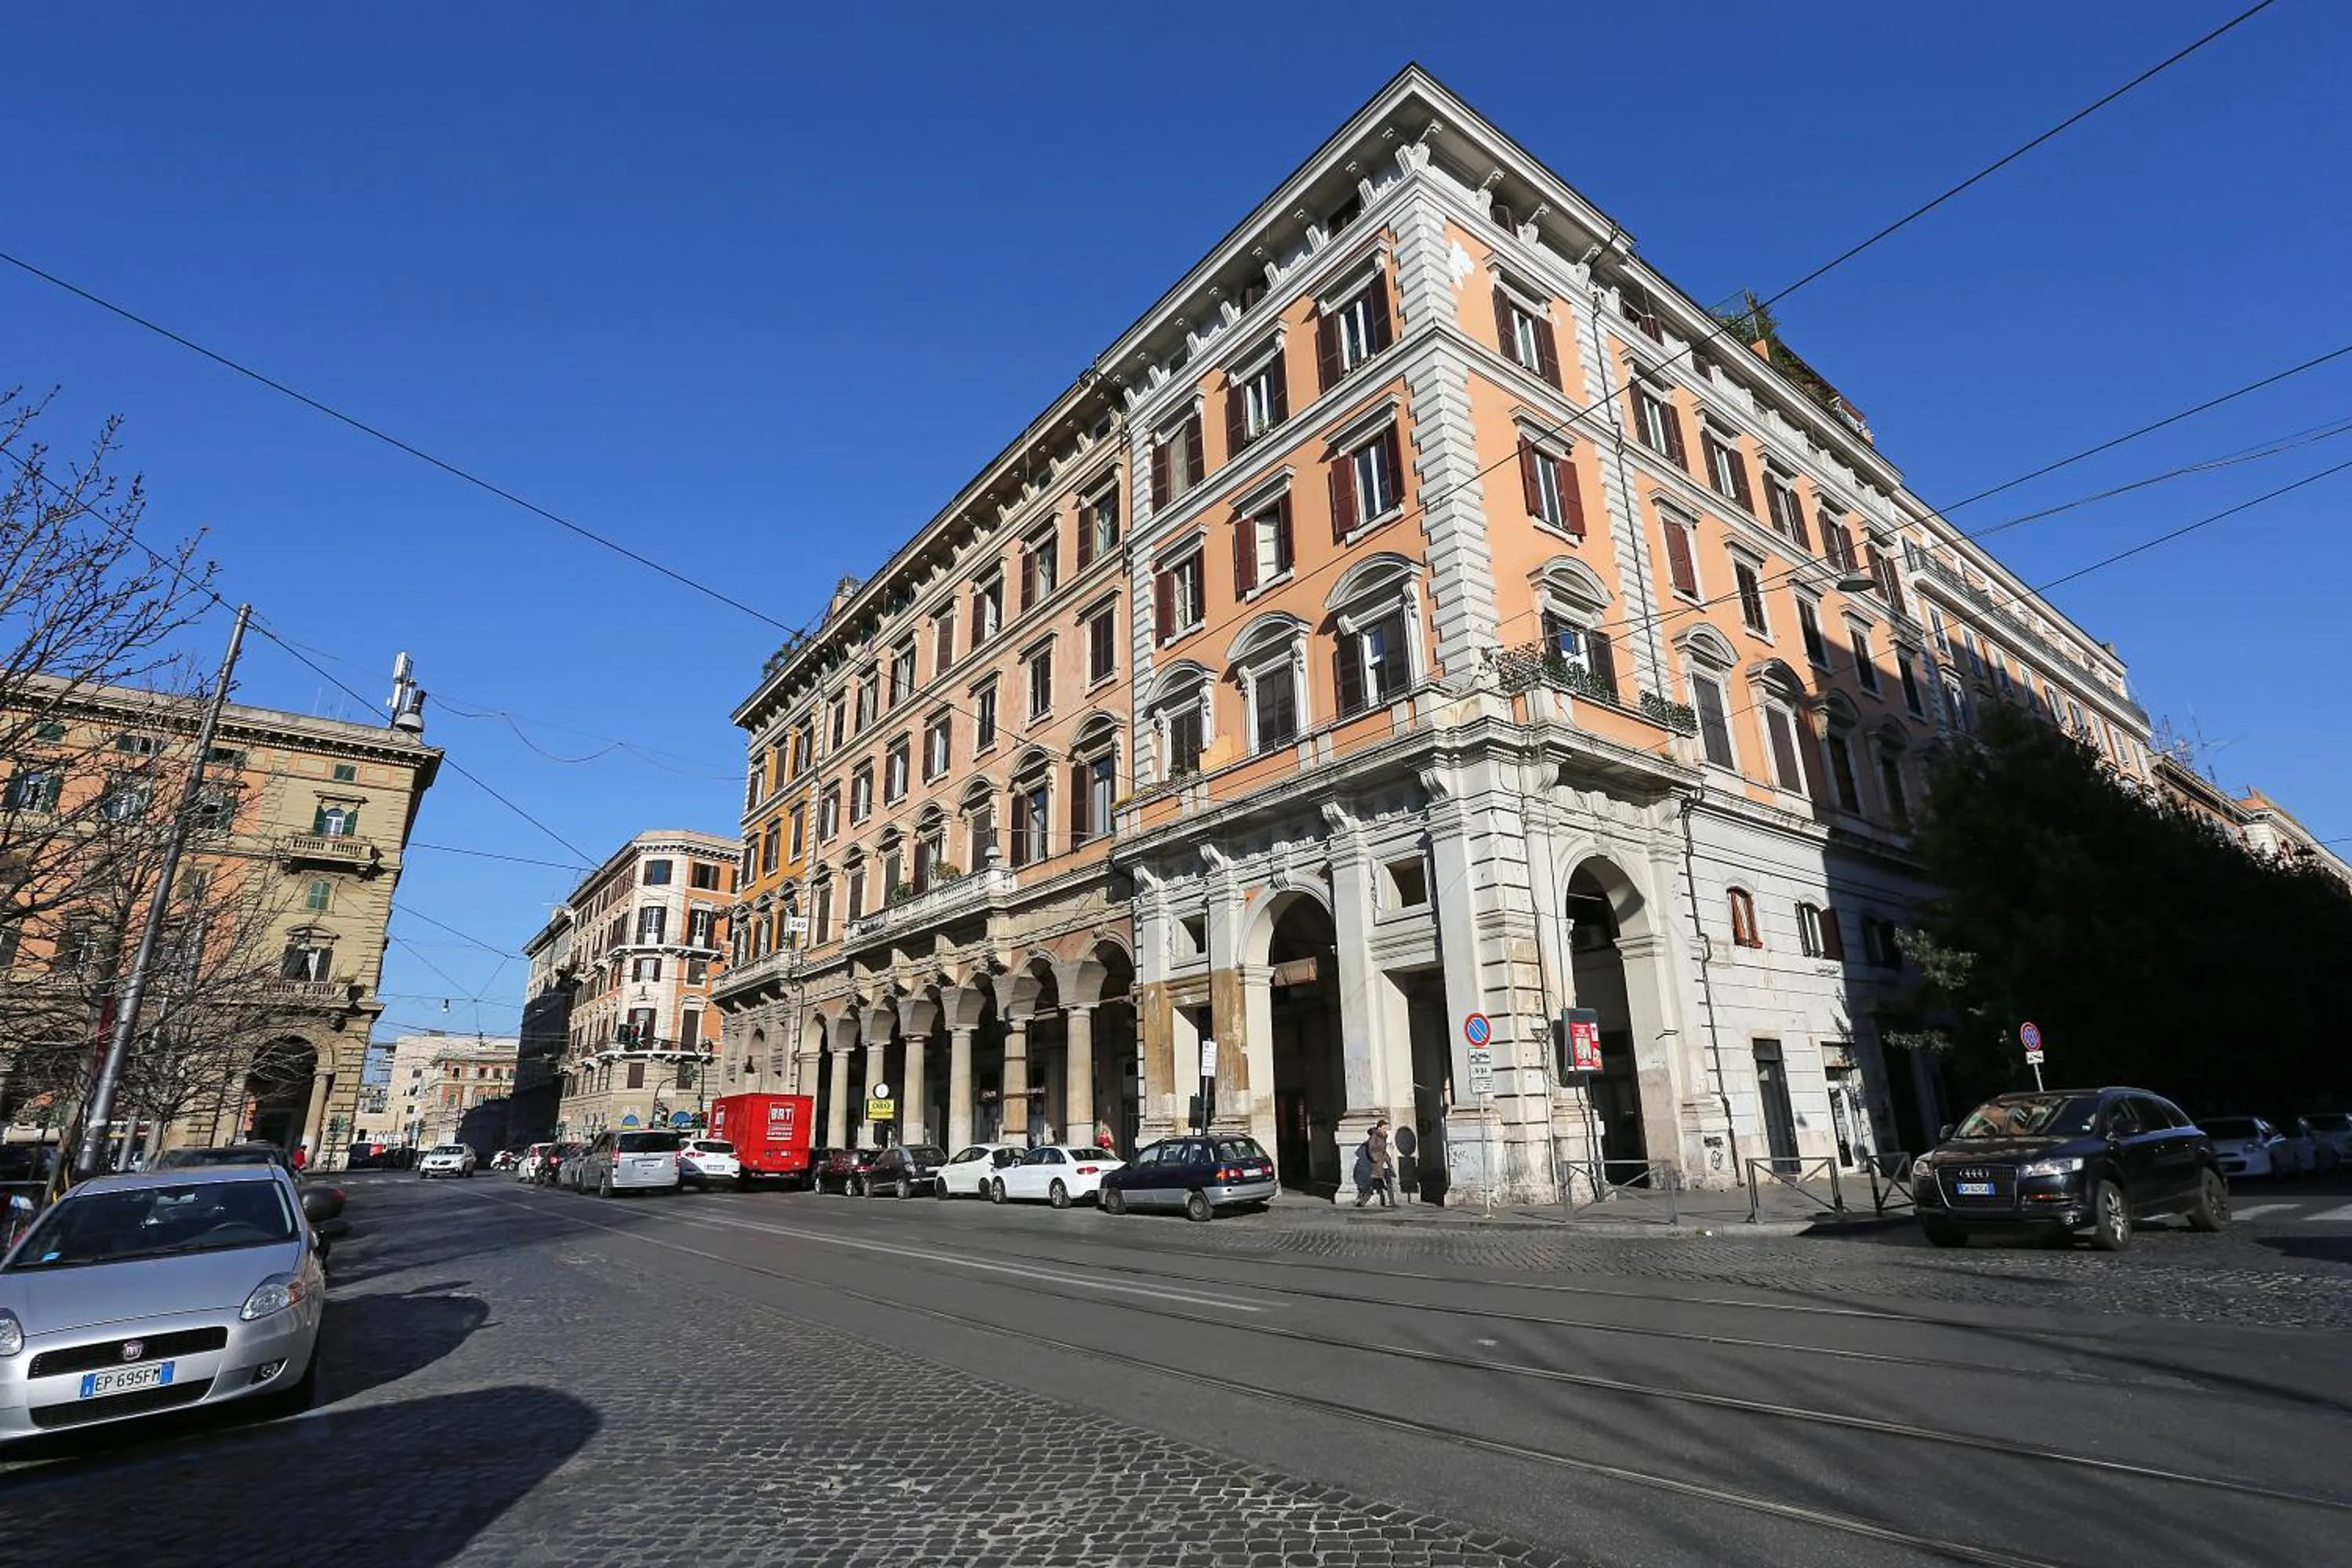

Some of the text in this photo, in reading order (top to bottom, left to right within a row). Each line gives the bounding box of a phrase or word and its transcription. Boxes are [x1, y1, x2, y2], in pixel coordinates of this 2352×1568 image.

[771, 1108, 792, 1121] BRT
[95, 1367, 161, 1392] EP 695FM
